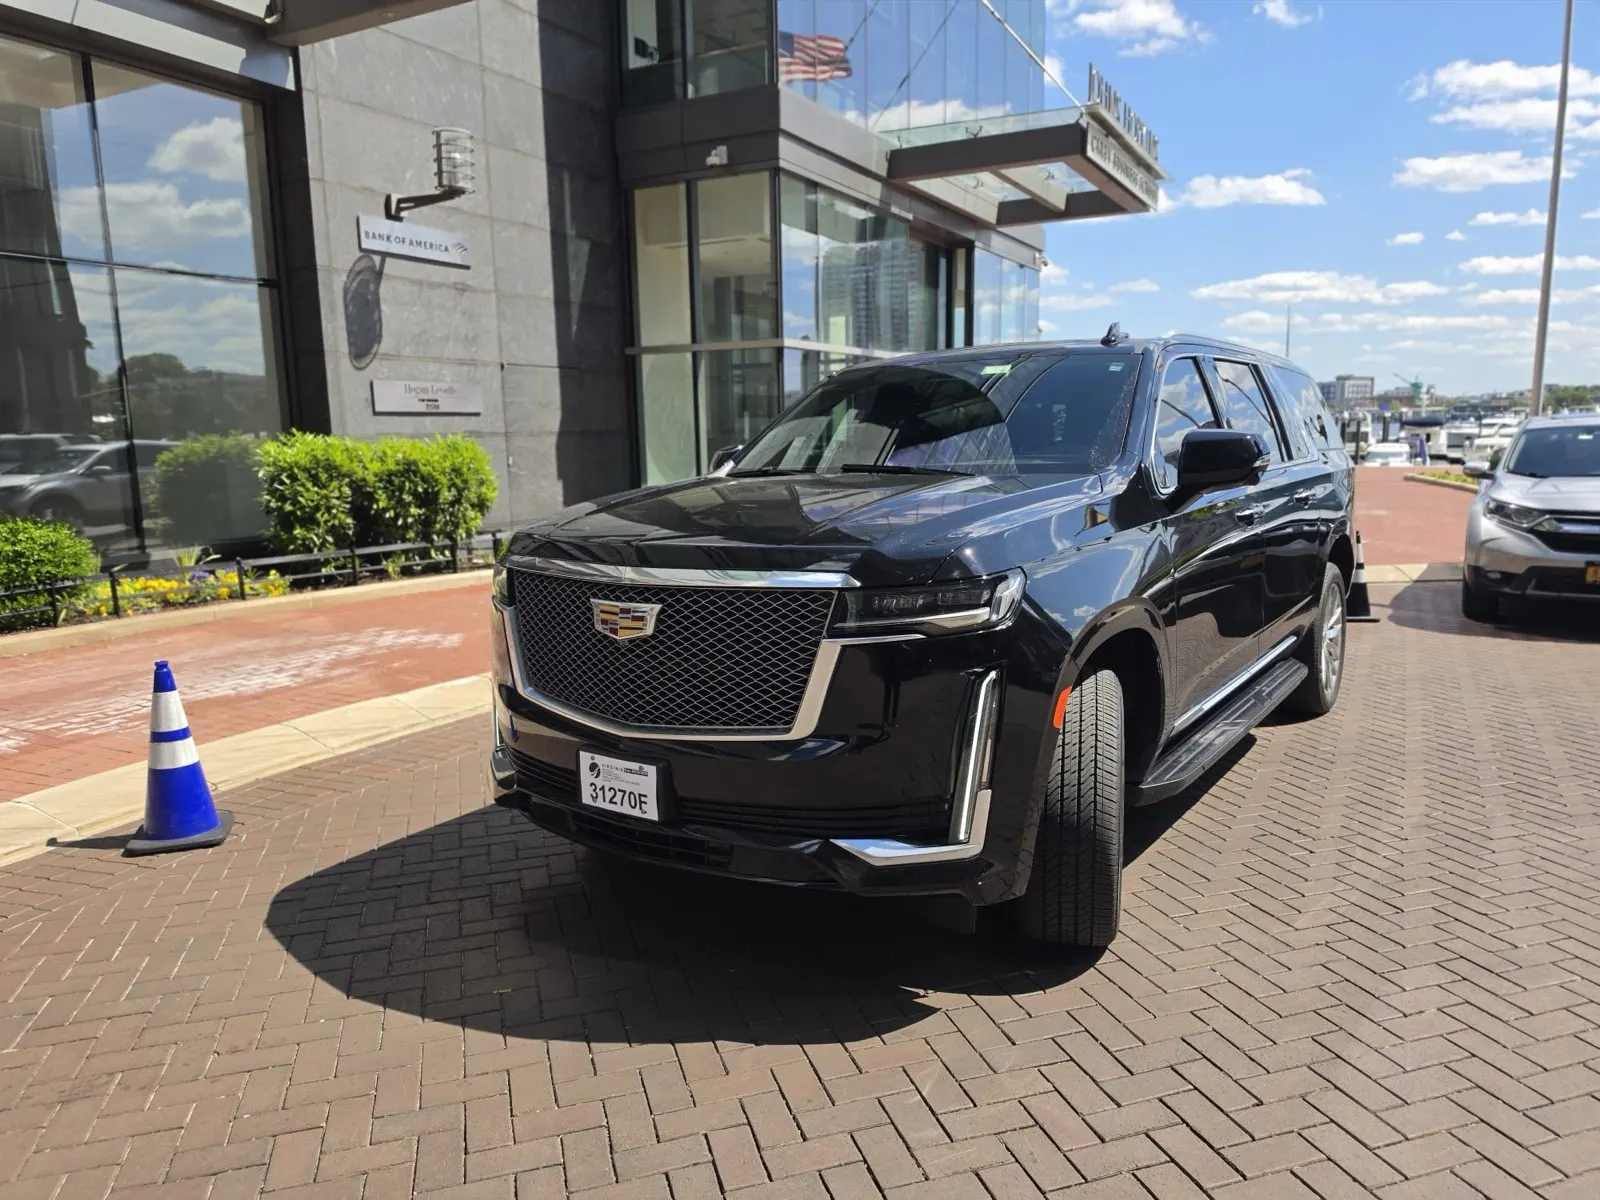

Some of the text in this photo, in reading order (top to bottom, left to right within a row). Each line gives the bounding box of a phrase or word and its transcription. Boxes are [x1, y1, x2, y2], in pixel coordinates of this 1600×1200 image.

[364, 230, 450, 253] BANK OF AMERICA
